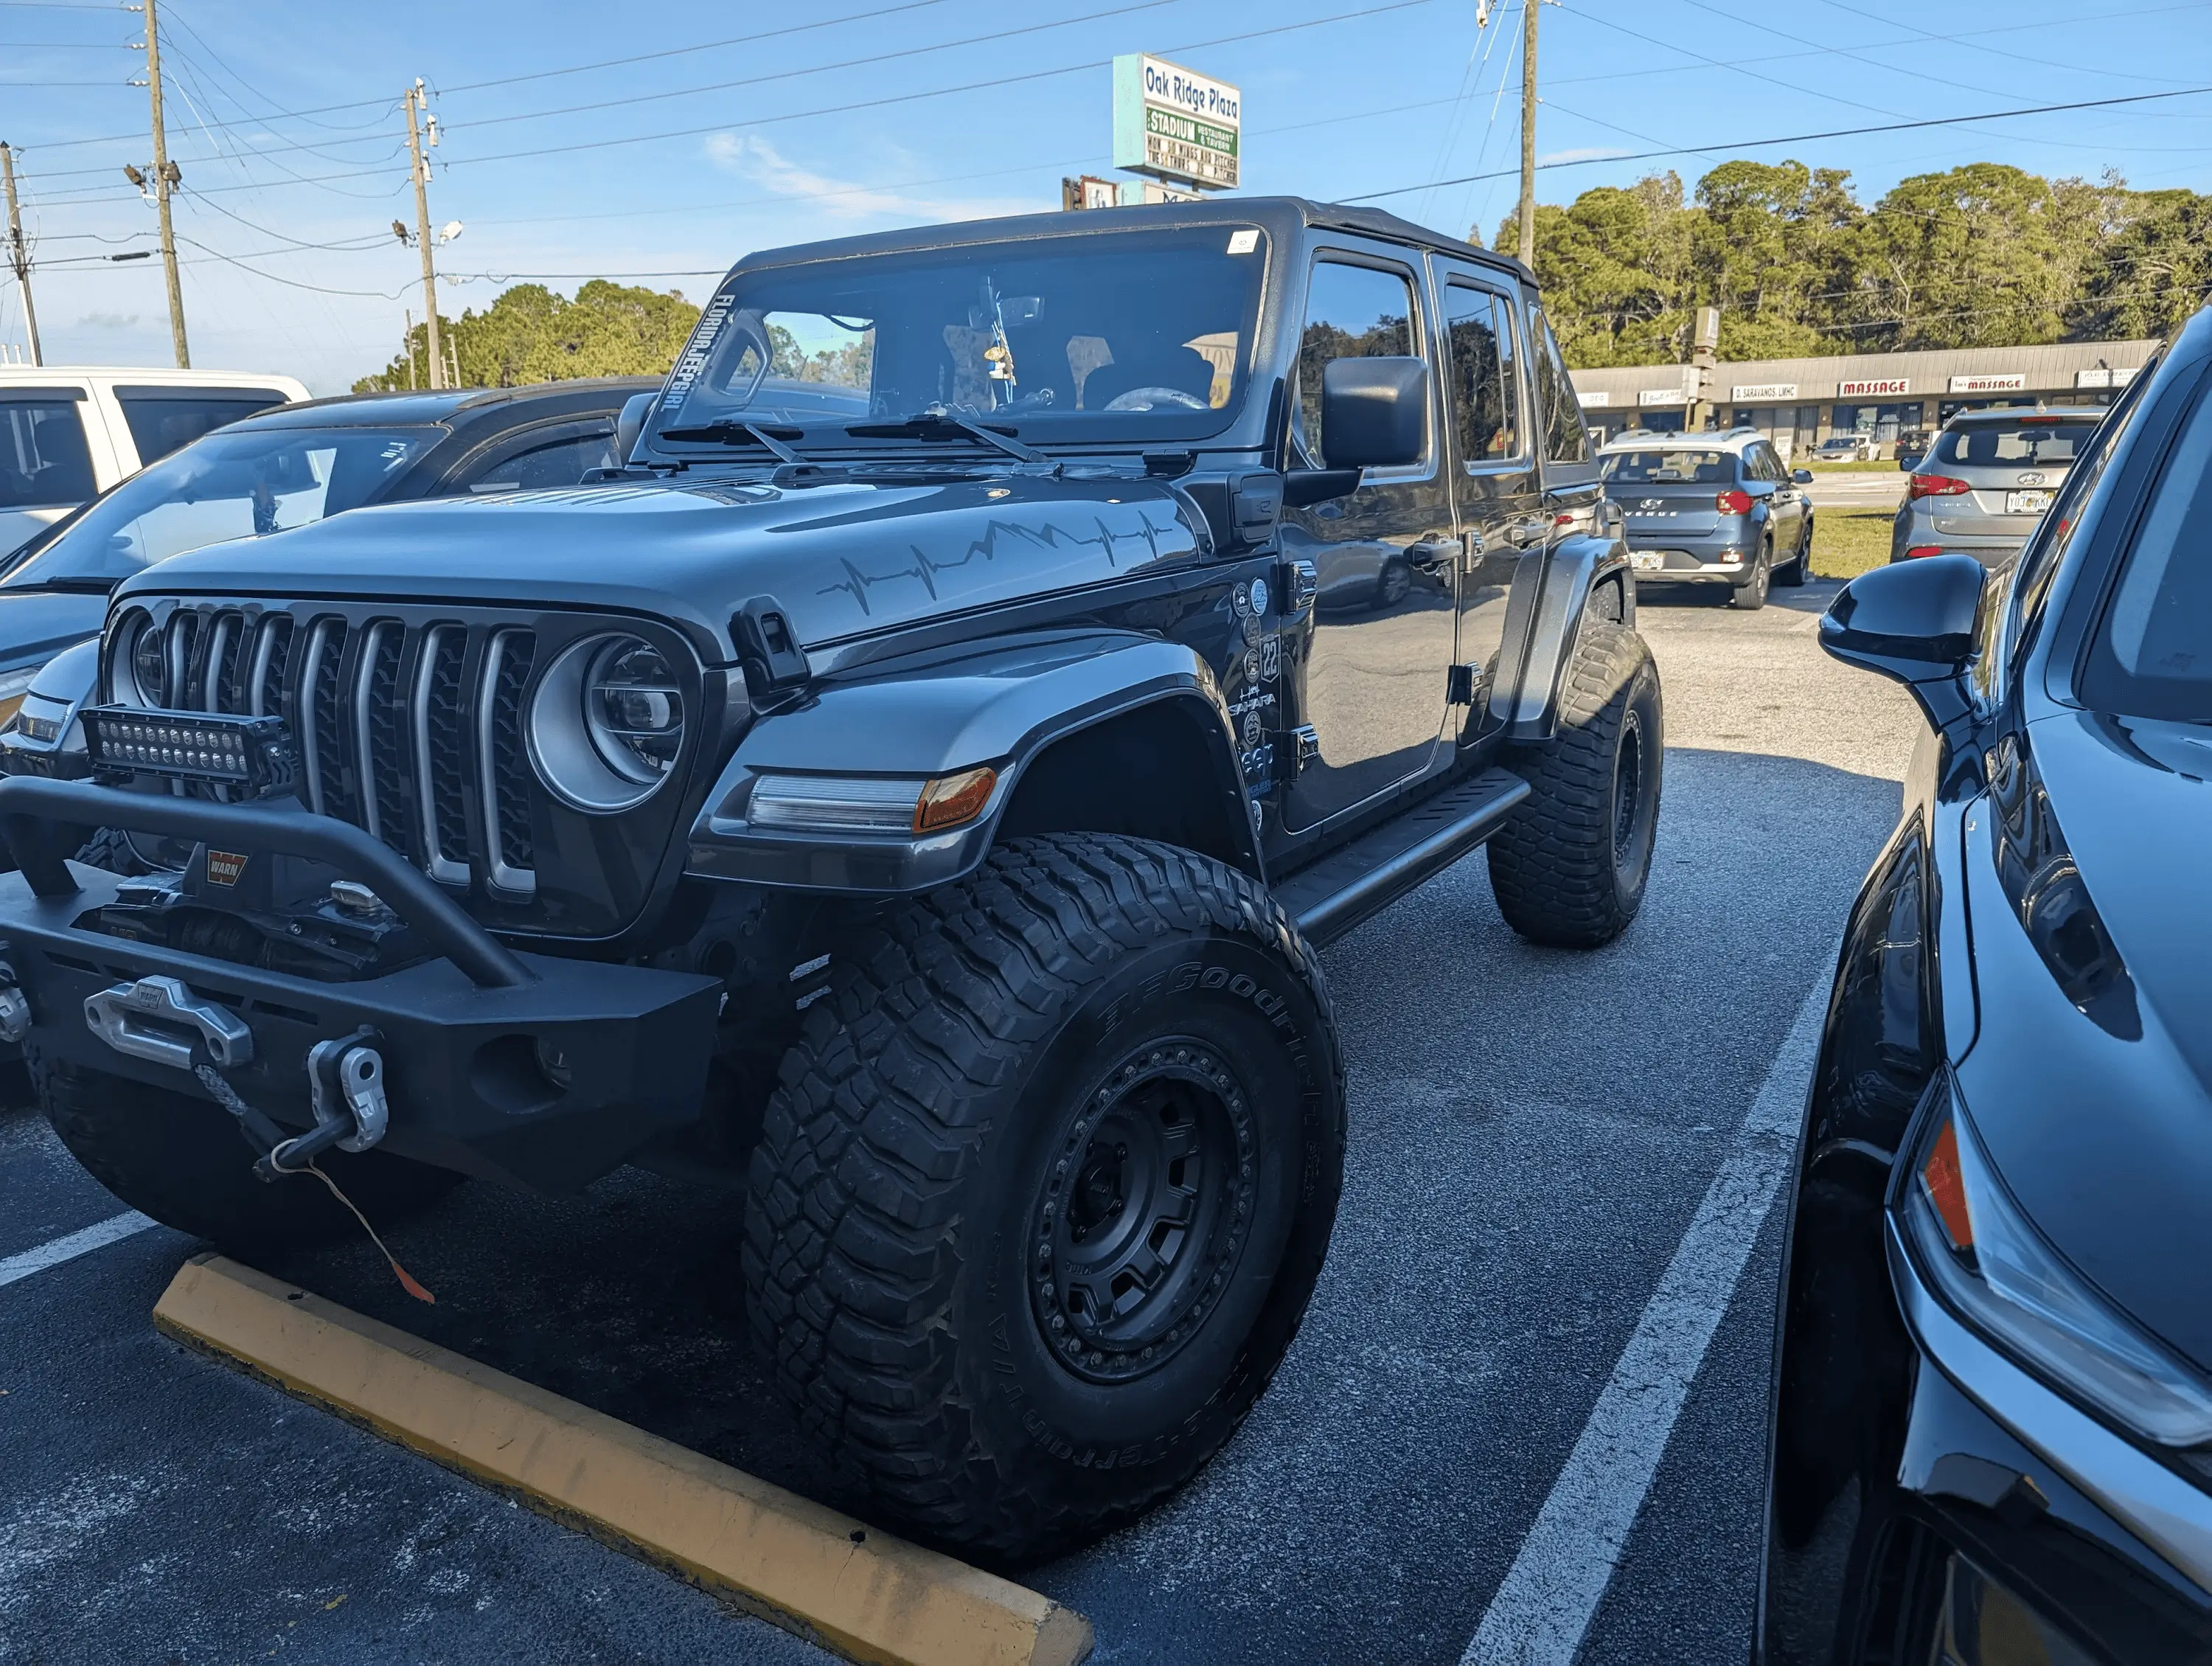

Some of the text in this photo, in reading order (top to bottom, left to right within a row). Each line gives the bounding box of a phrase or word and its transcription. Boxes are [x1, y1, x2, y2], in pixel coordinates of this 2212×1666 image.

[1146, 66, 1237, 119] Oak Ridge Plaza
[1151, 111, 1195, 142] STADIUM
[660, 294, 736, 413] FLORIDAJEEPGIRL
[1843, 381, 1907, 395] MASSAGE
[1968, 381, 2020, 390] MASSAGE
[1263, 641, 1277, 677] 22
[1227, 693, 1276, 717] SAHARA
[210, 860, 239, 878] WARN
[140, 990, 159, 1003] WARN
